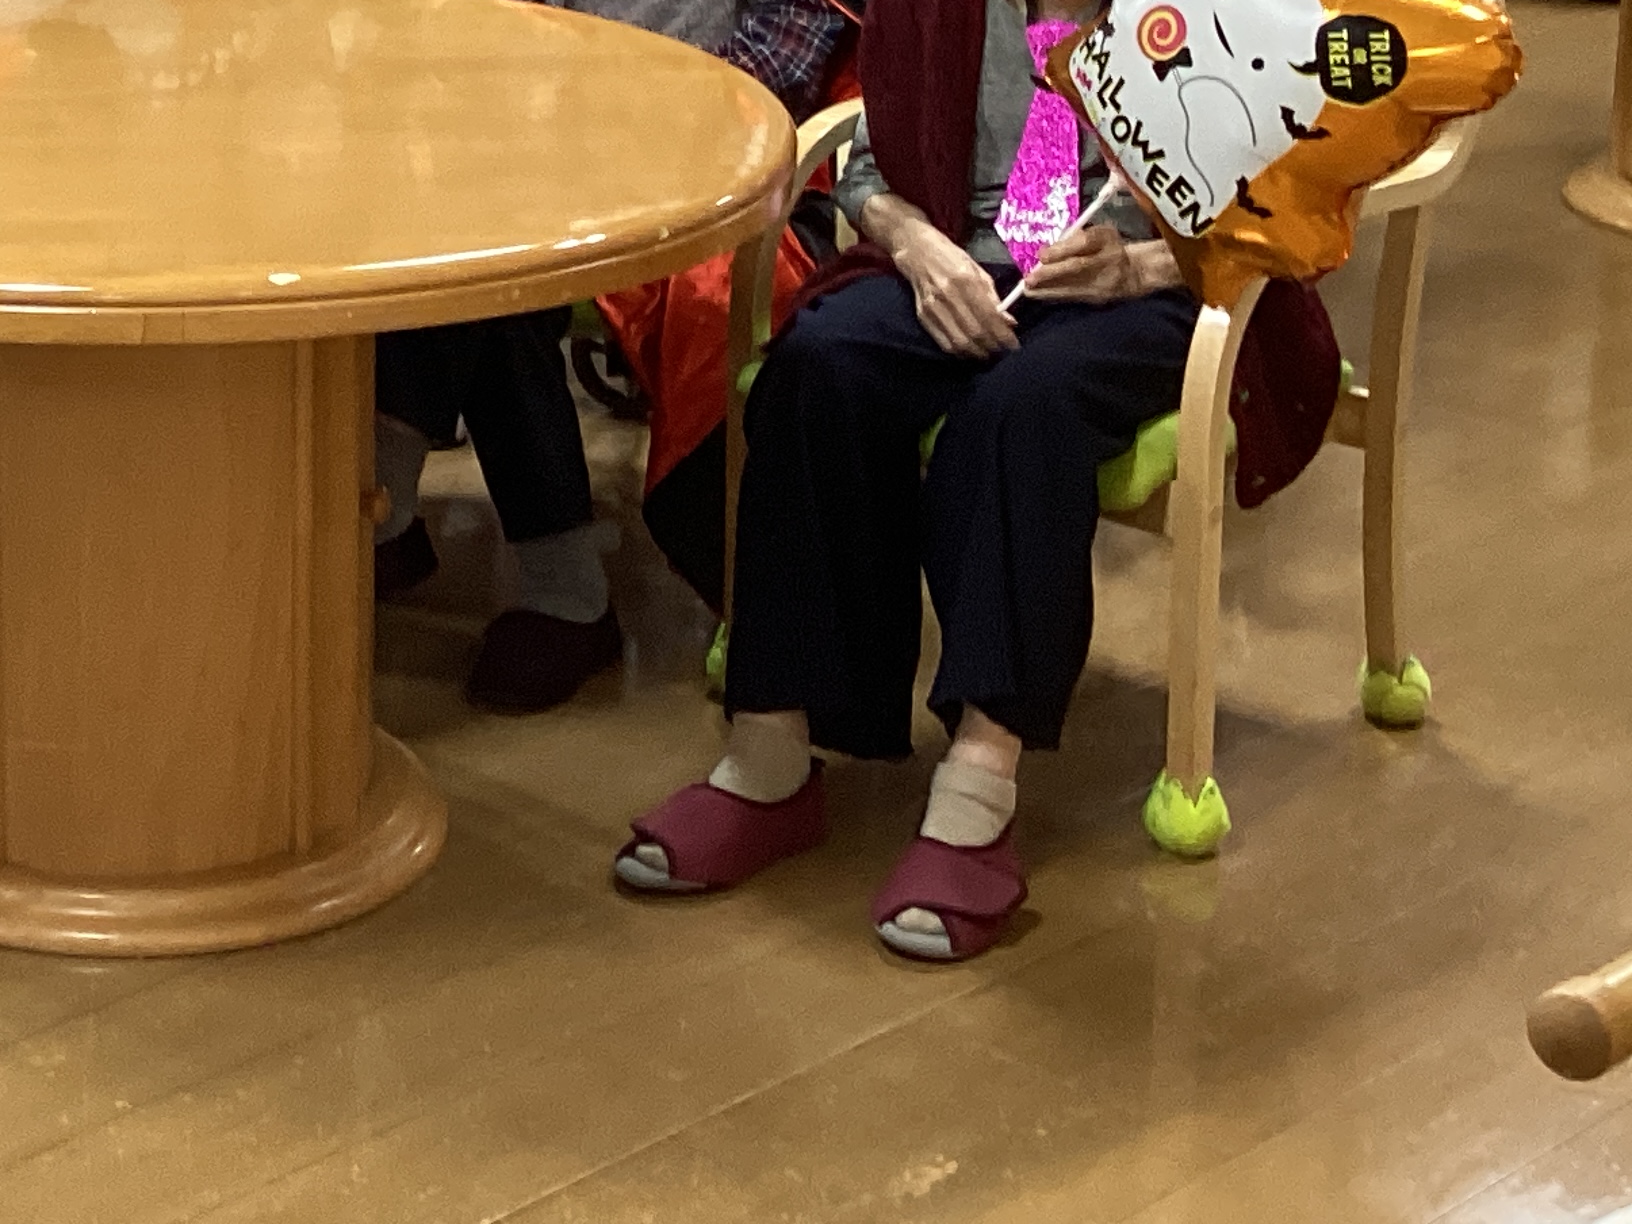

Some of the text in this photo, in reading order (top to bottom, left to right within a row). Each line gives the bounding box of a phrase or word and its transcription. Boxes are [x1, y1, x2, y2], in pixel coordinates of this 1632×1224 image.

[1327, 27, 1352, 89] TREAT
[1367, 28, 1393, 87] TRICK
[1079, 33, 1216, 236] HALLOWEEN
